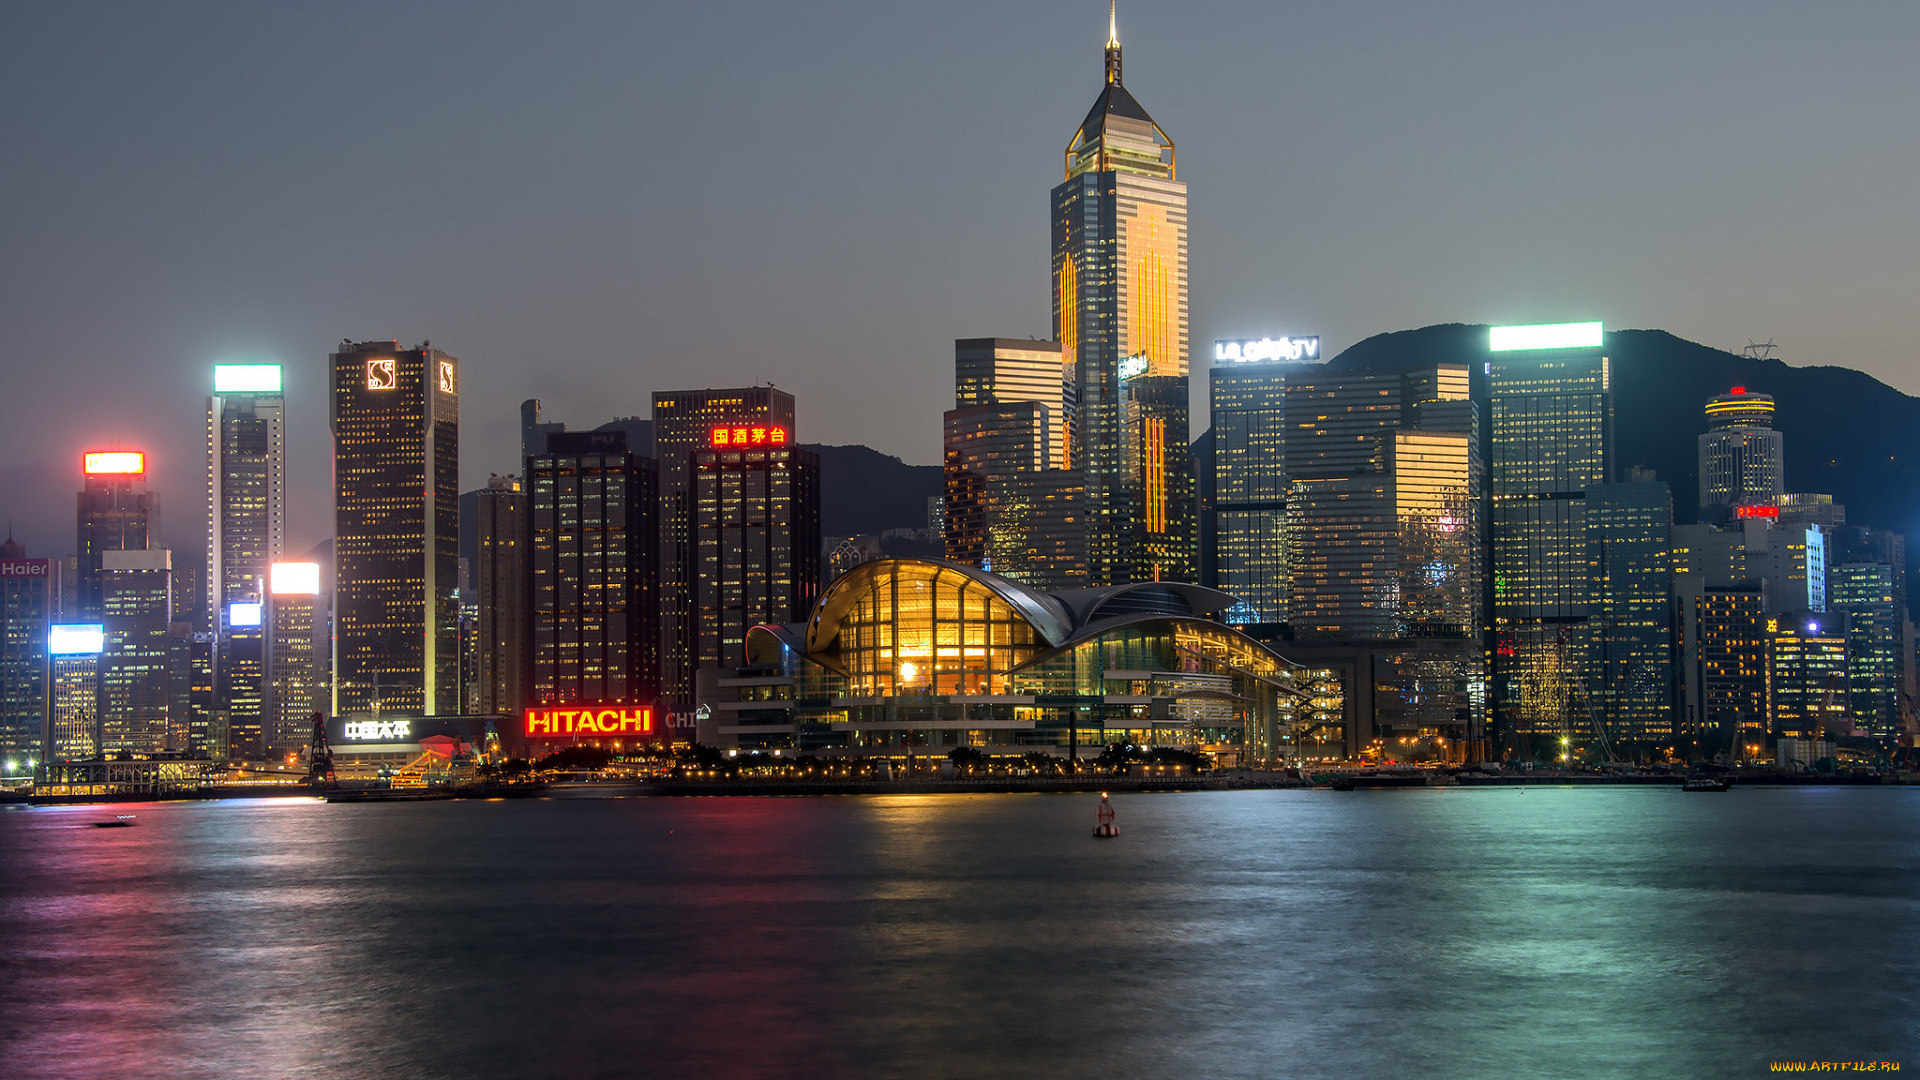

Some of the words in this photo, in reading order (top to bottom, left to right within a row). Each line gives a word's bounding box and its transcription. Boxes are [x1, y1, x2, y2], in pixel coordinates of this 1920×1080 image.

[713, 427, 785, 444] 国酒茅台
[2, 562, 47, 575] Haier
[344, 721, 410, 740] 中国太平
[528, 710, 650, 733] HITACHI
